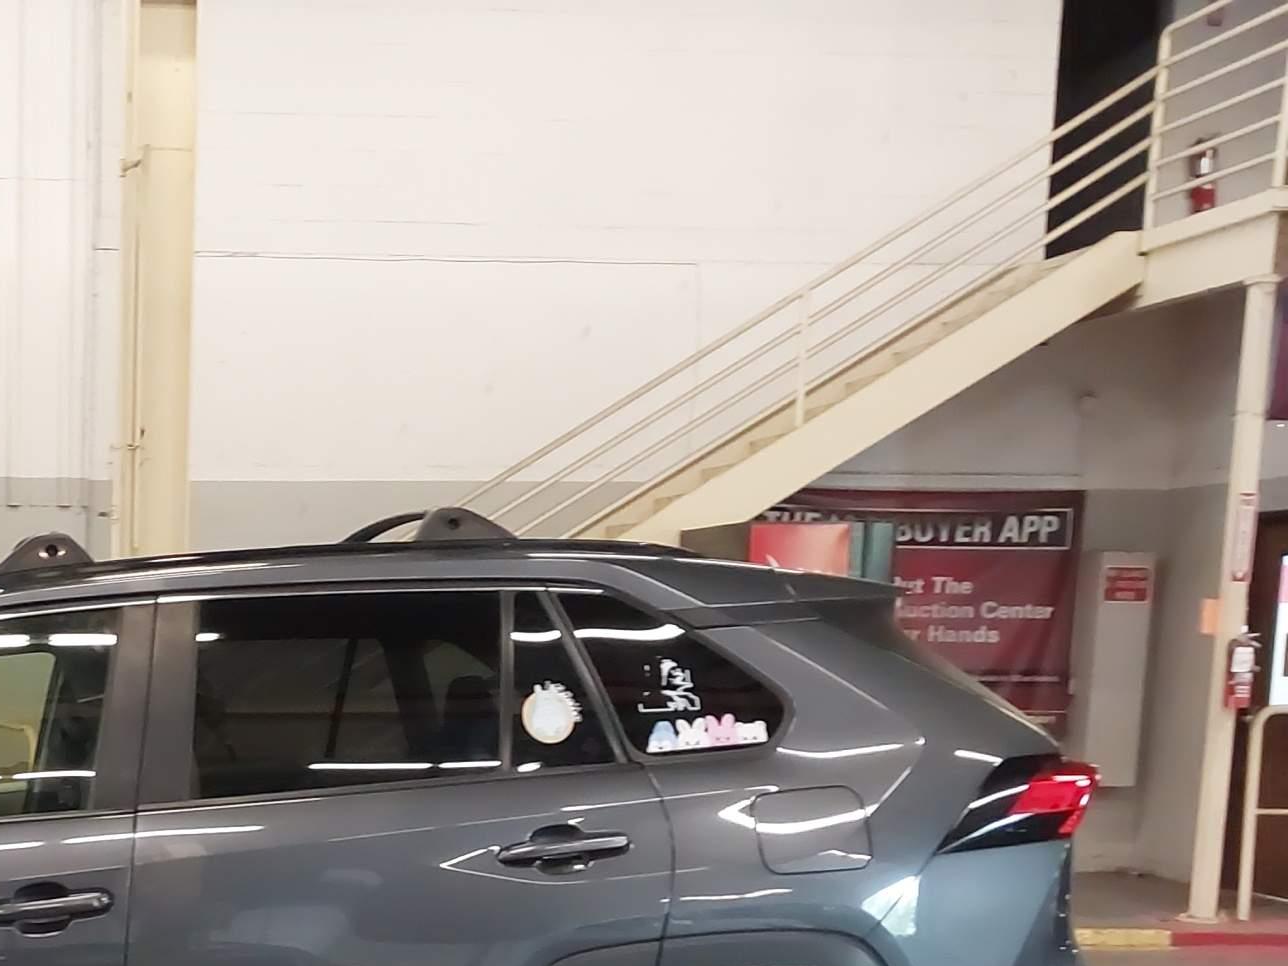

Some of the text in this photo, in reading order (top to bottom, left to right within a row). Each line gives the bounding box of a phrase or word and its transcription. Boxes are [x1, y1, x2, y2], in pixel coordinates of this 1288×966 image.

[997, 515, 1061, 543] APP
[931, 576, 974, 594] The
[980, 601, 1055, 619] Center
[927, 625, 1000, 643] Hands
